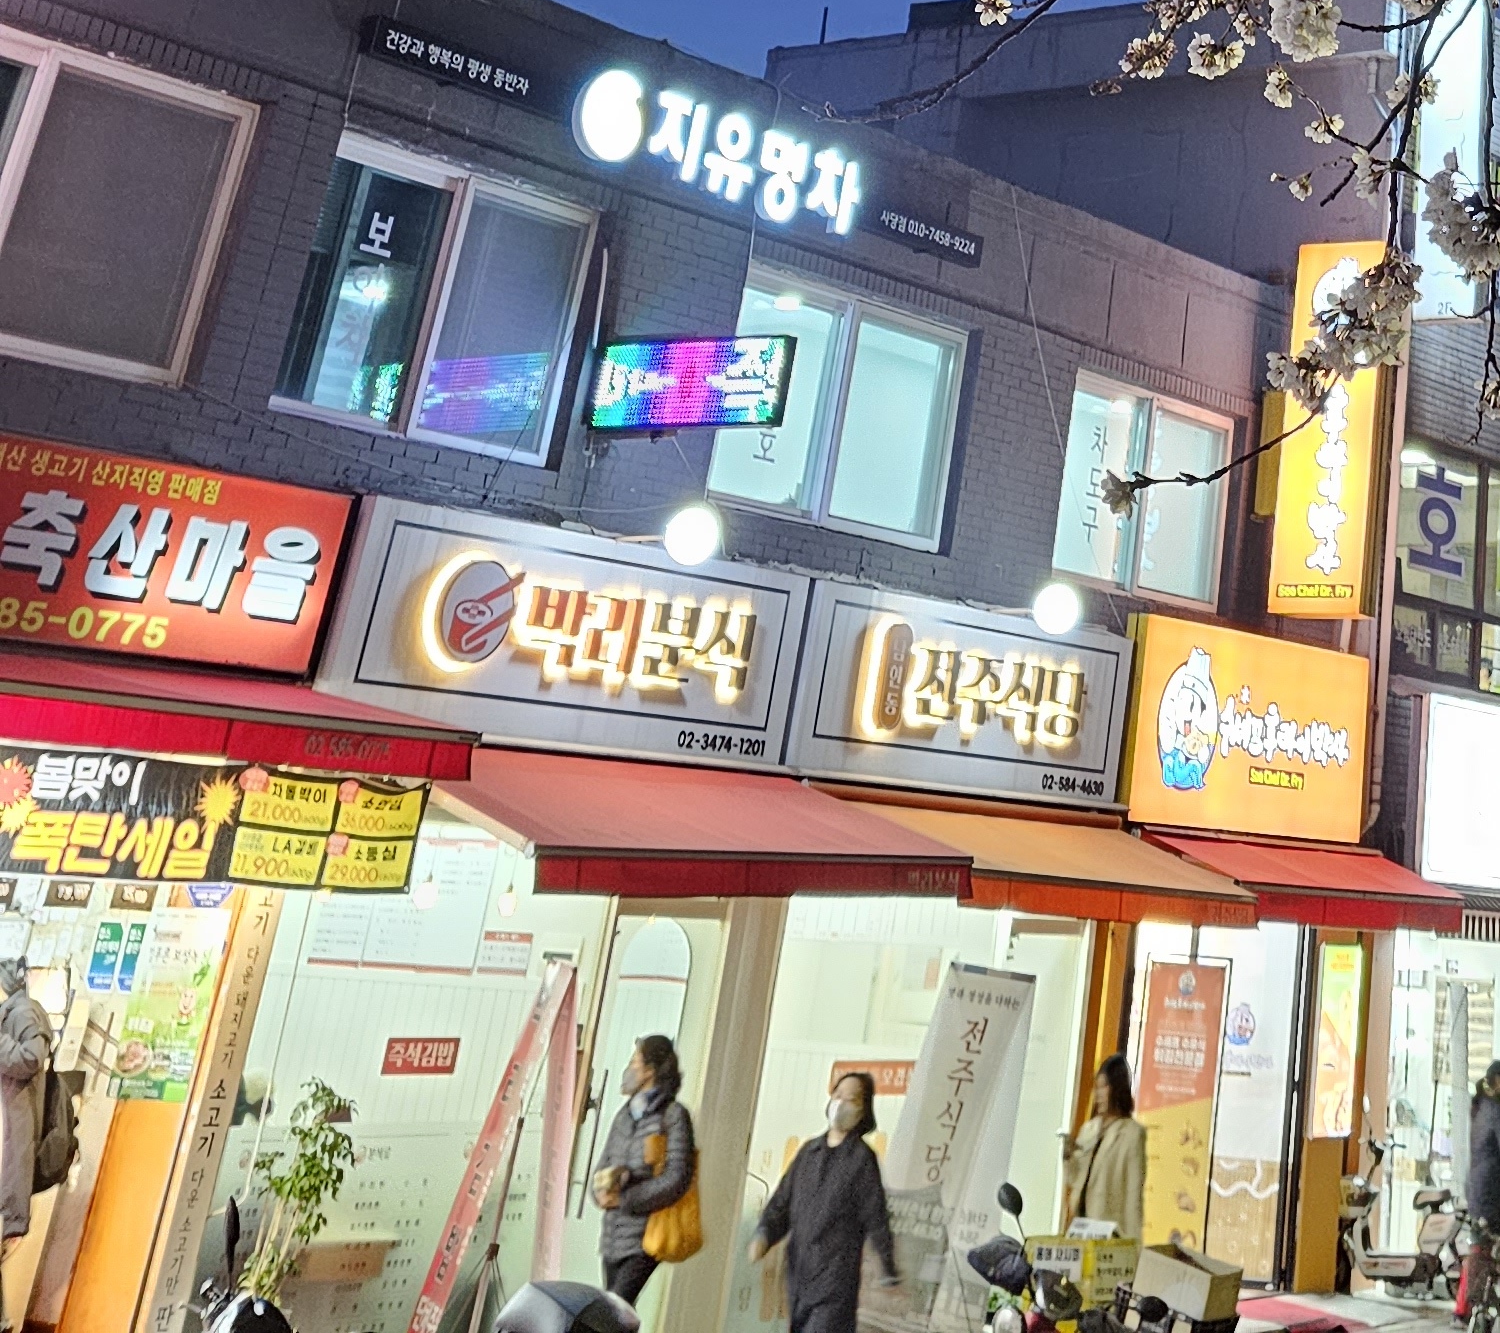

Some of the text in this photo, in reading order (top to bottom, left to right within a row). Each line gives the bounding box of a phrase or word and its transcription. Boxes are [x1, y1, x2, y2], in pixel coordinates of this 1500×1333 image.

[386, 29, 530, 96] 건강과 행복의 평생 동반자
[648, 89, 862, 236] 지유명차
[30, 445, 87, 482] 생고기
[90, 460, 166, 495] 산지직영
[166, 473, 223, 506] 판매점
[1081, 426, 1109, 544] 차도구
[0, 489, 321, 622] 축산마을
[913, 645, 1088, 740] 전주식당
[677, 730, 766, 757] 02-3474-1201
[31, 751, 148, 807] 봄맞이
[272, 781, 328, 805] 차돌박이
[1041, 774, 1105, 797] 02-584-4630
[10, 809, 220, 880] 폭탄세일
[242, 946, 261, 986] 다운
[222, 990, 249, 1071] 돼지고기
[387, 1040, 456, 1068] 즉석김밥
[196, 1078, 228, 1159] 소고기
[926, 1016, 989, 1183] 전주식당
[186, 1167, 205, 1210] 다운
[166, 1216, 193, 1298] 소고기만
